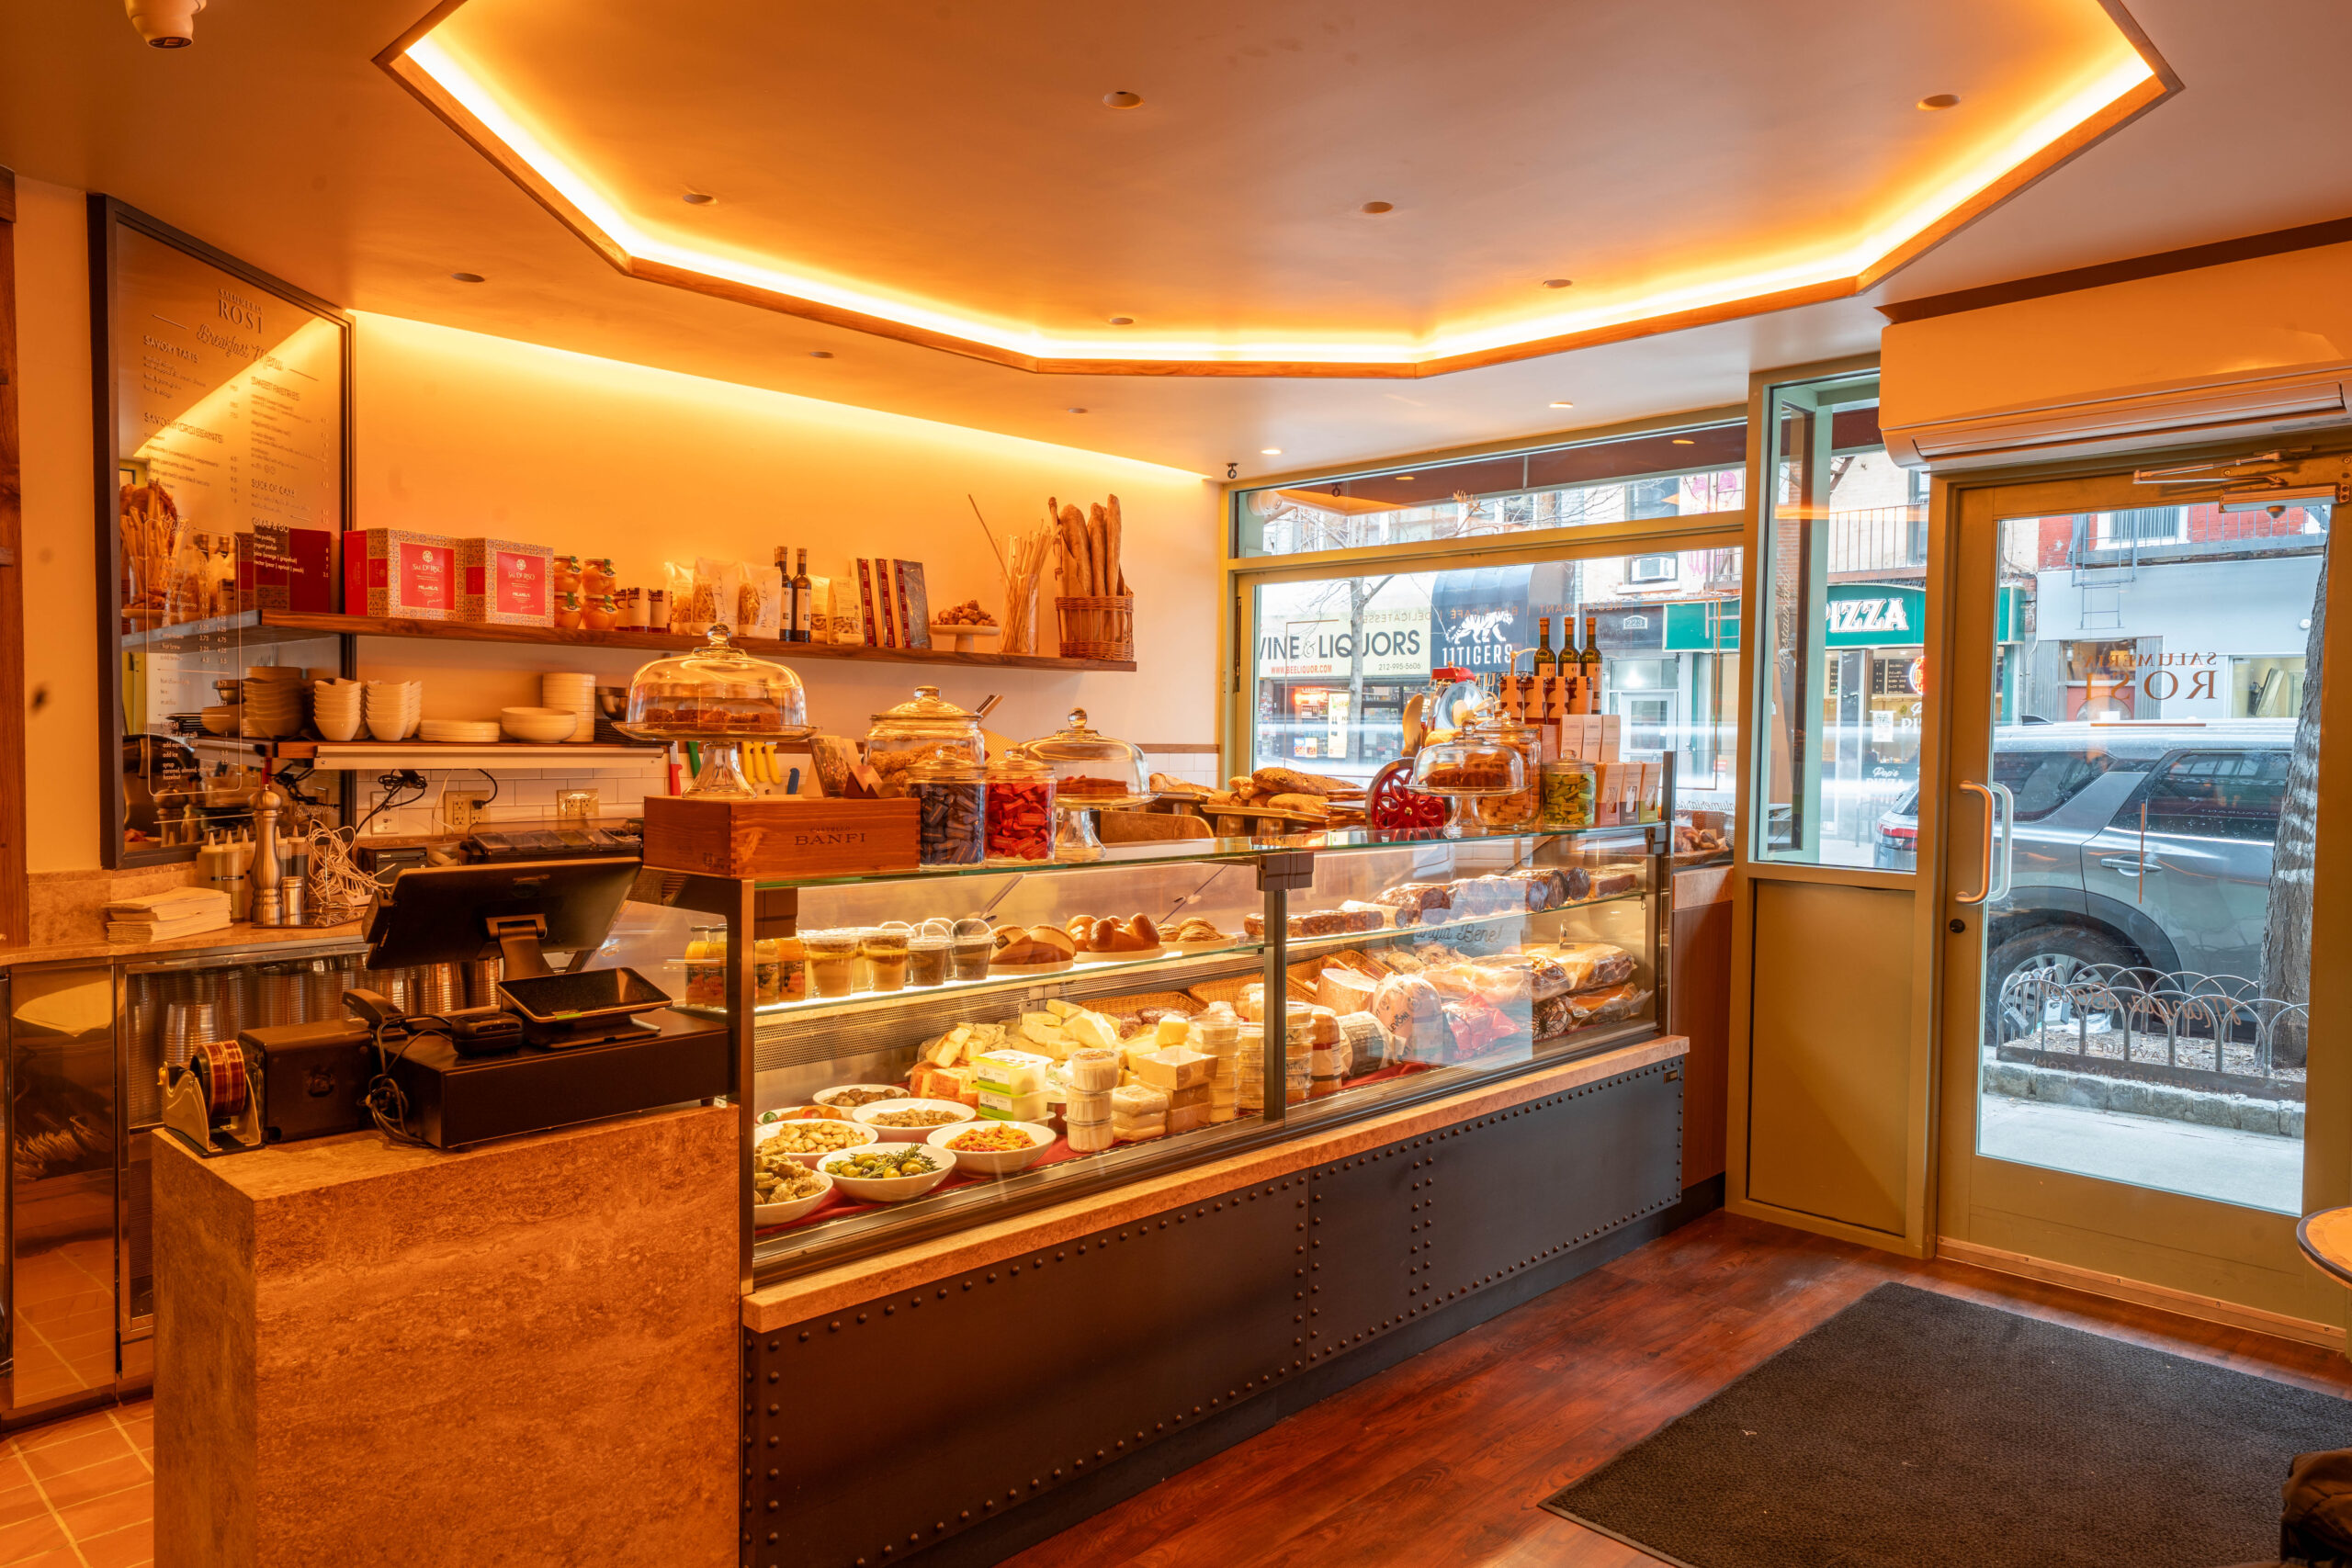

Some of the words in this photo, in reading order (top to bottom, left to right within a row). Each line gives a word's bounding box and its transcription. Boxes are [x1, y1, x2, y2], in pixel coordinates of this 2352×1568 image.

[219, 299, 262, 334] ROSI
[196, 323, 250, 358] Breakfast
[1824, 597, 1909, 634] IZZA
[1442, 642, 1514, 666] 11TIGERS
[1271, 664, 1332, 675] WWW.BEELIQUOR.COM
[1378, 662, 1421, 671] 212-995-5606
[1871, 766, 1900, 778] Pop's
[794, 832, 867, 847] BANFI
[1455, 922, 1504, 943] Bene!
[1387, 1011, 1411, 1033] LEVONI
